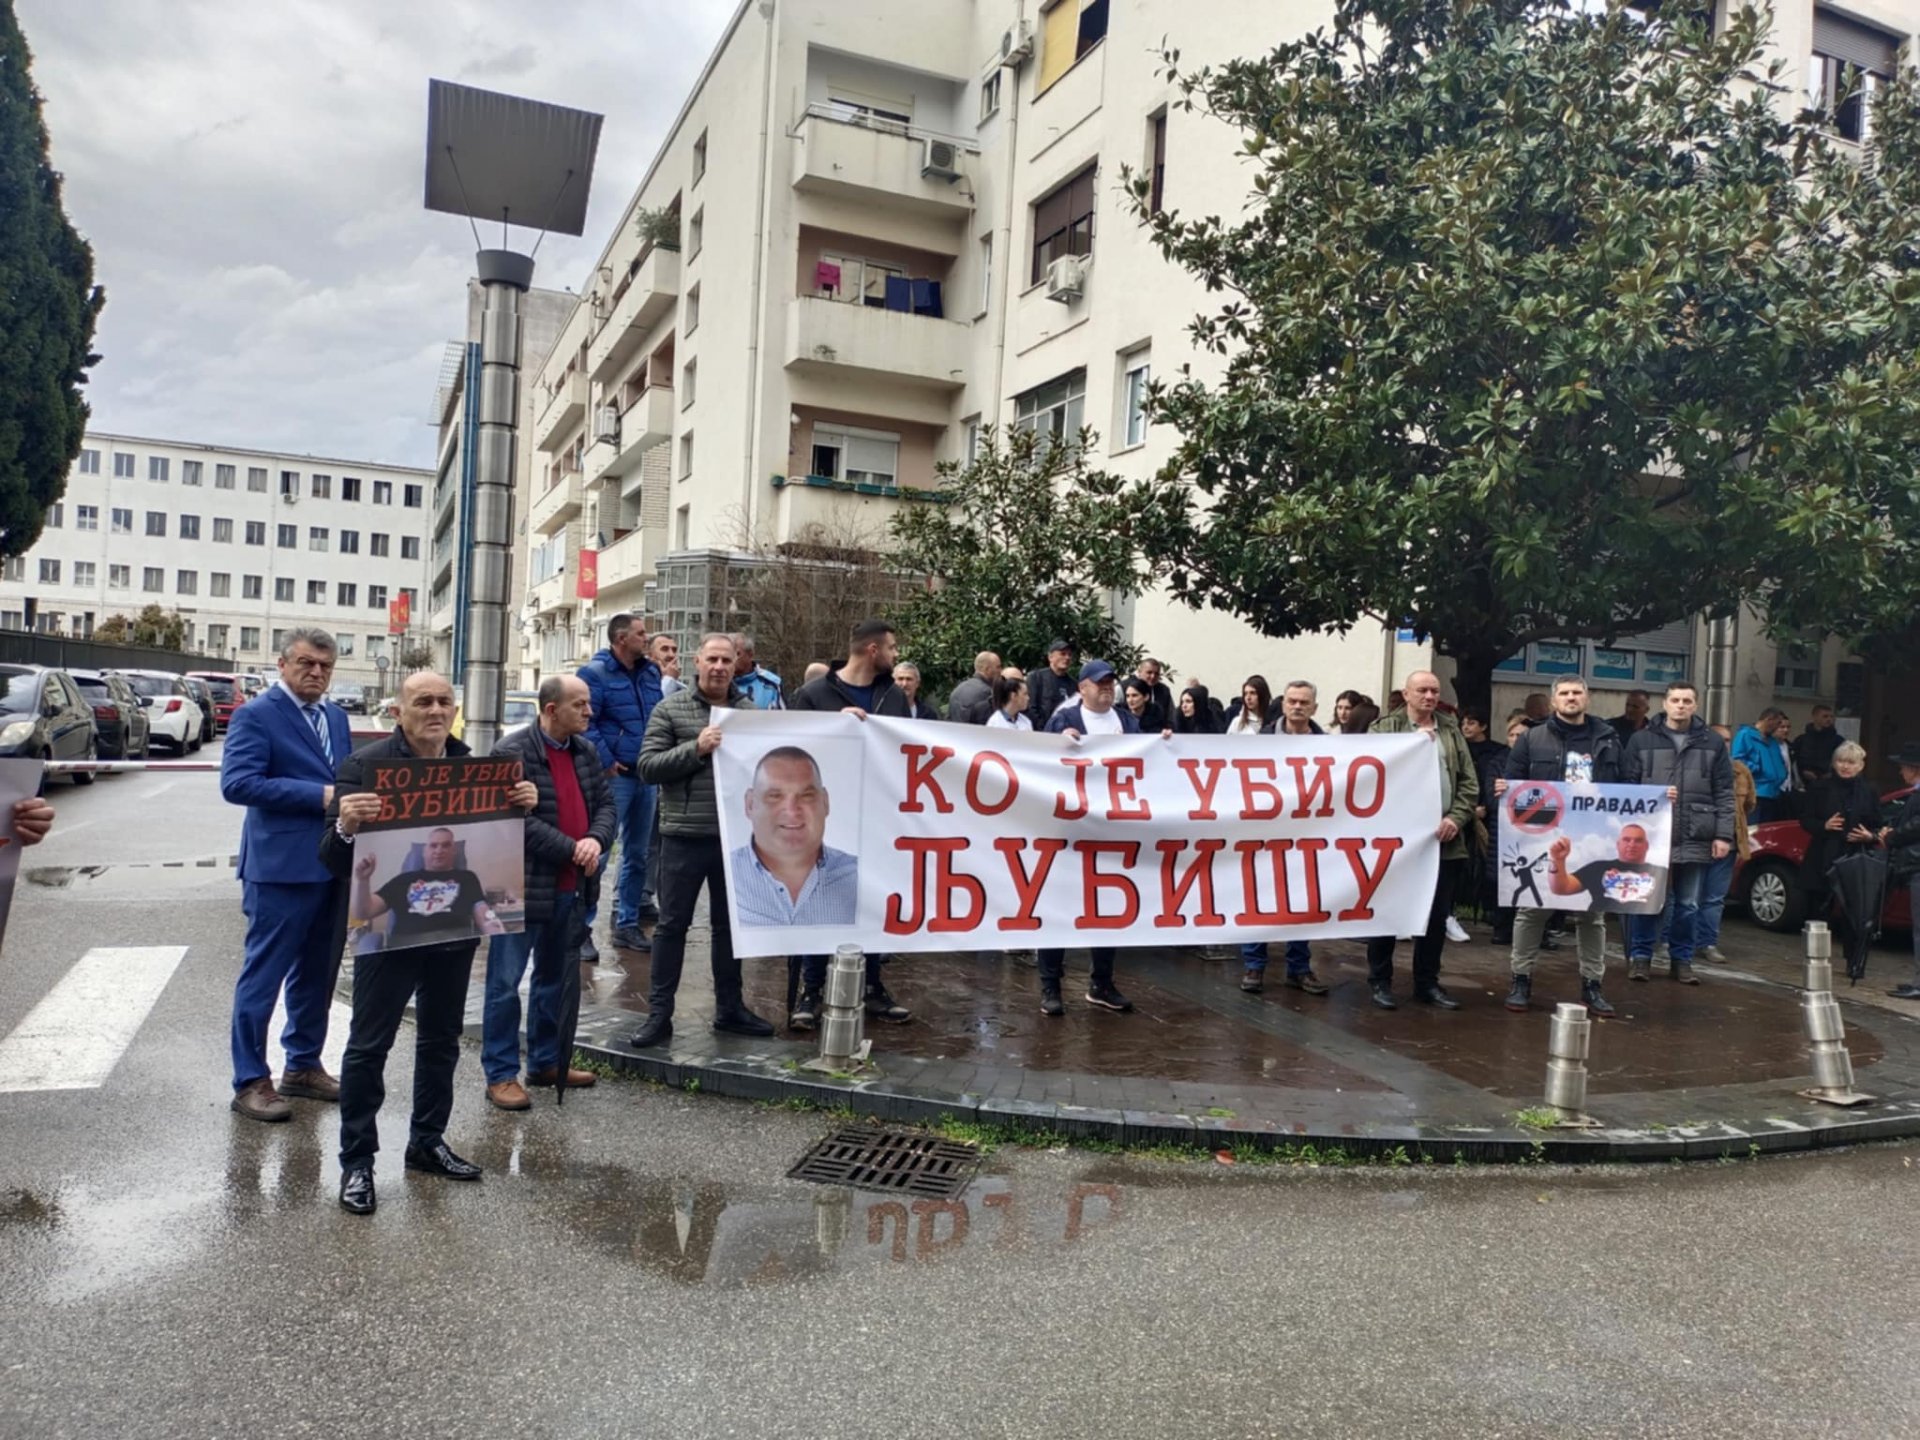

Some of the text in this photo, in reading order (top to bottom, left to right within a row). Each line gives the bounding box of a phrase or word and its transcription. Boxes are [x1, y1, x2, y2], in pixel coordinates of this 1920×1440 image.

[374, 760, 523, 790] КО ЈЕ УБИО
[899, 743, 1386, 820] КО ЈЕ УБИО
[1571, 796, 1658, 815] ПРАВДА?
[883, 836, 1403, 936] ЉУБИШУ
